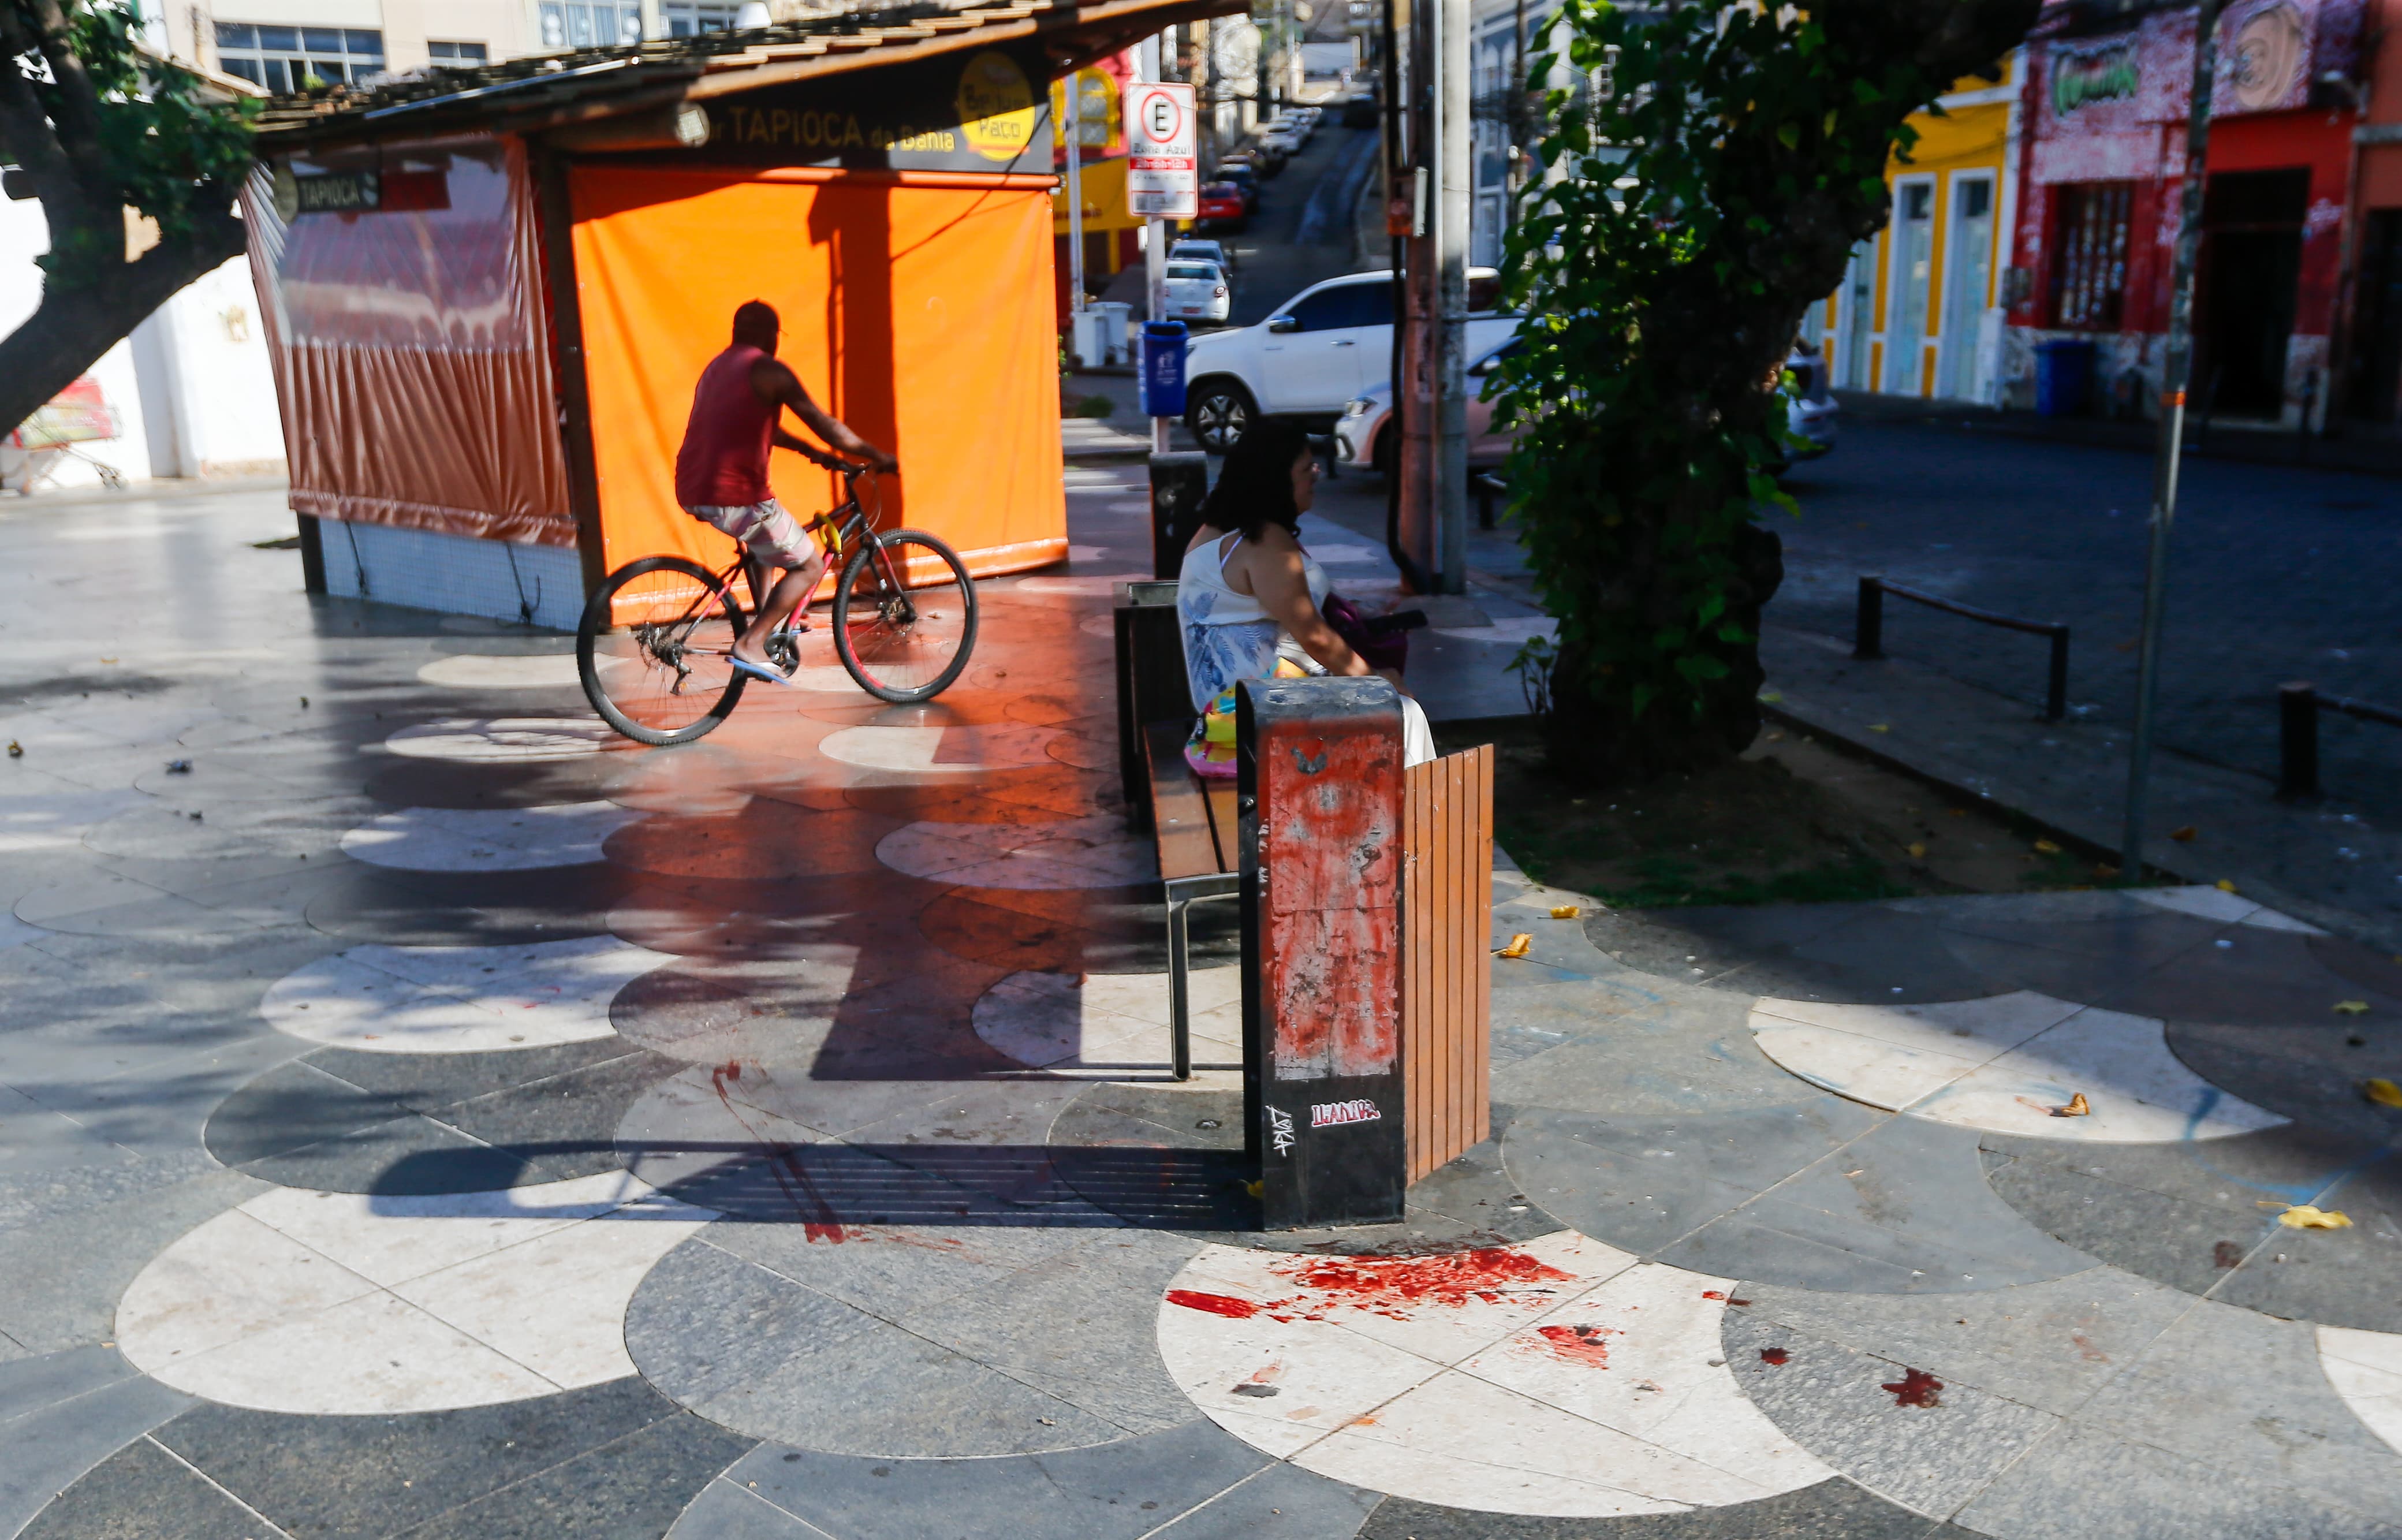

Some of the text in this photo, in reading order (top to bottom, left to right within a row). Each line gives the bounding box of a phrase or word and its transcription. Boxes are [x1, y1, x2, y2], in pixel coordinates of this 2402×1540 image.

[729, 107, 864, 147] TAPIOCA
[899, 124, 956, 152] Bahia
[1156, 104, 1168, 131] E
[1166, 143, 1191, 155] Azul
[300, 178, 360, 208] TAPIOCA
